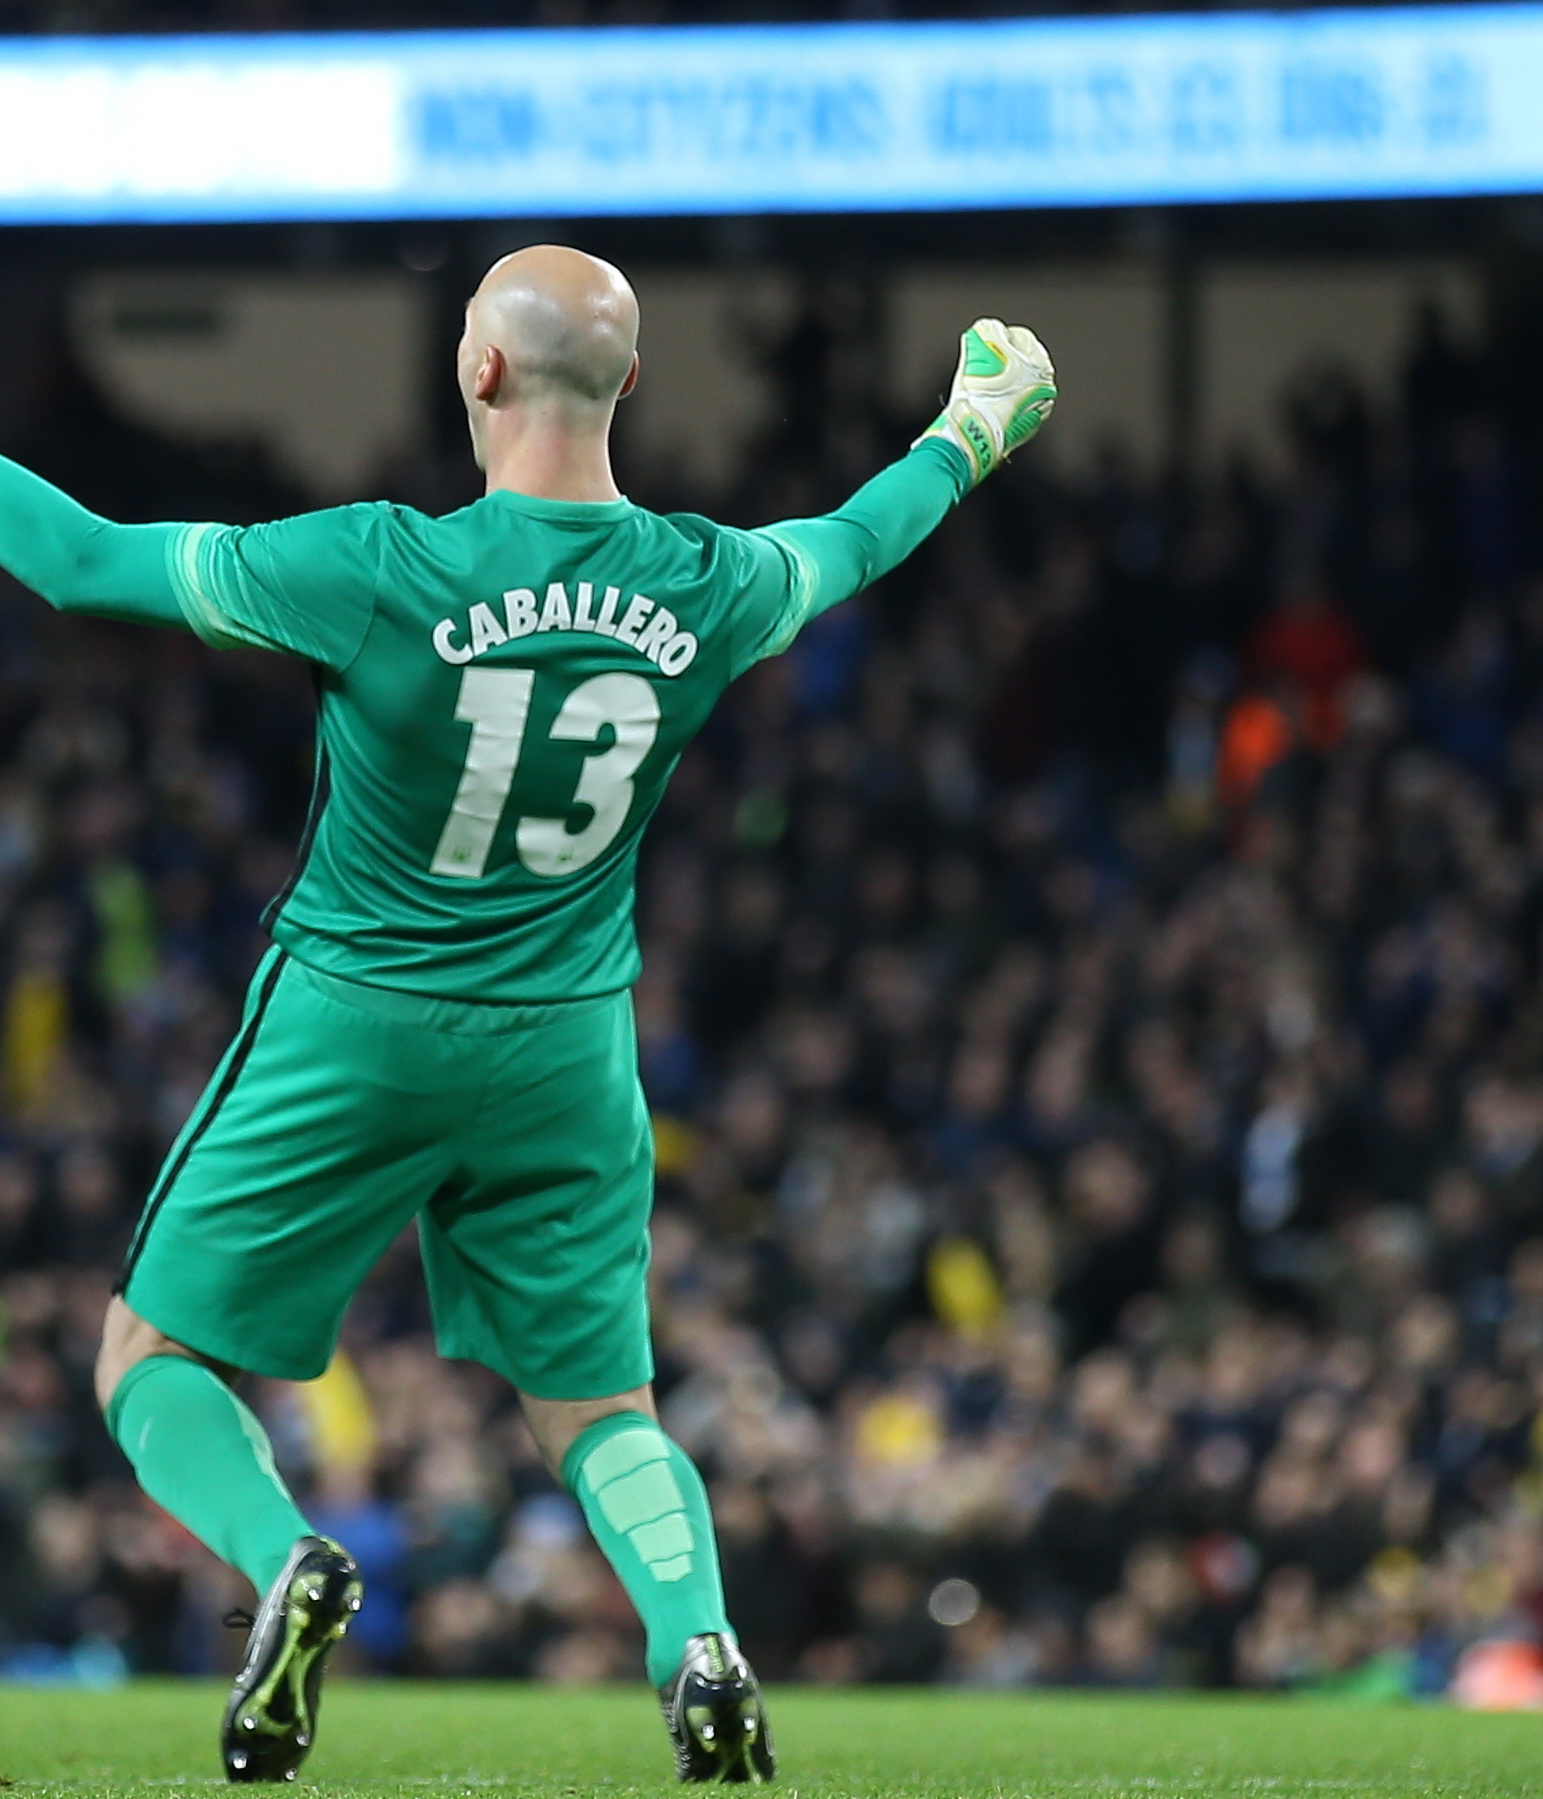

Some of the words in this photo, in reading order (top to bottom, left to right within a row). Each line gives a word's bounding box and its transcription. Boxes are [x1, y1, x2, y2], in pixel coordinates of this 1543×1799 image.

[967, 420, 991, 469] W13
[432, 581, 699, 677] CABALLERO
[429, 666, 662, 880] 13
